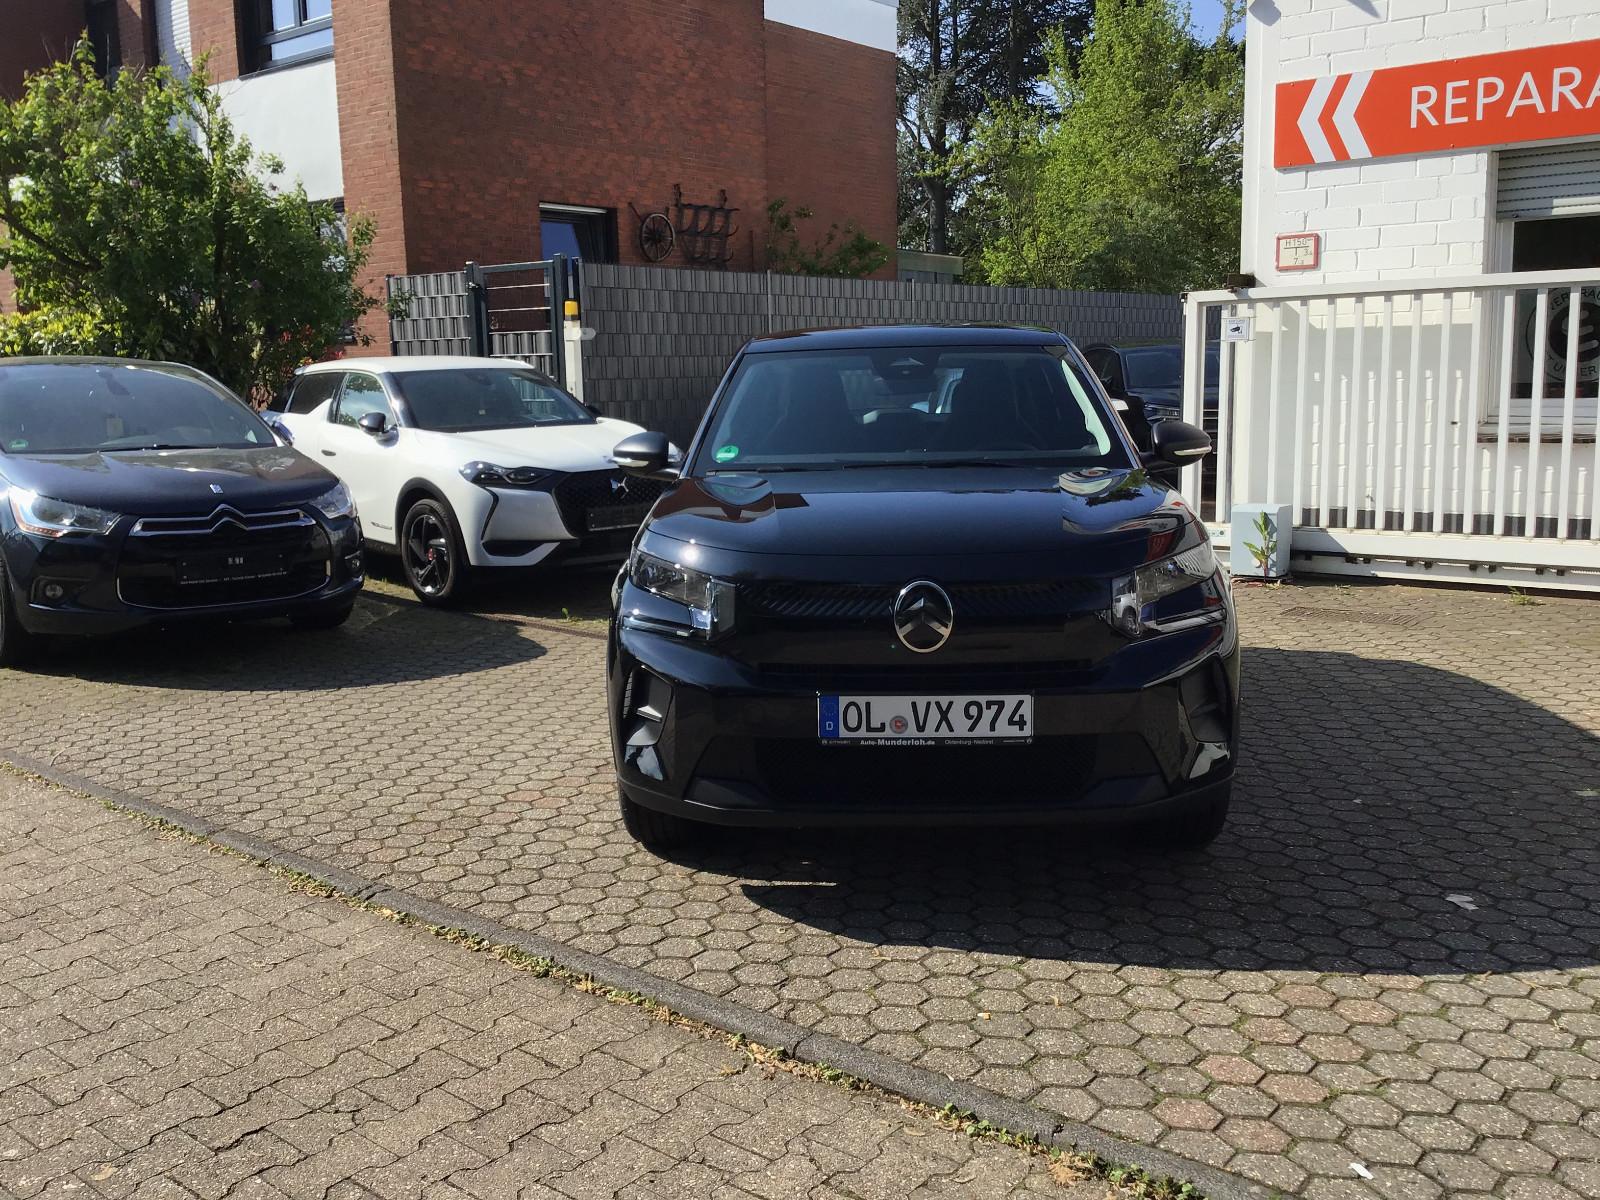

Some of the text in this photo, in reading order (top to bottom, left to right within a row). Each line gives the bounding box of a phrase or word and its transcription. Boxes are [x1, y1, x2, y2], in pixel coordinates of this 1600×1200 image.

[826, 721, 833, 731] D
[842, 699, 1028, 733] OL VX 974
